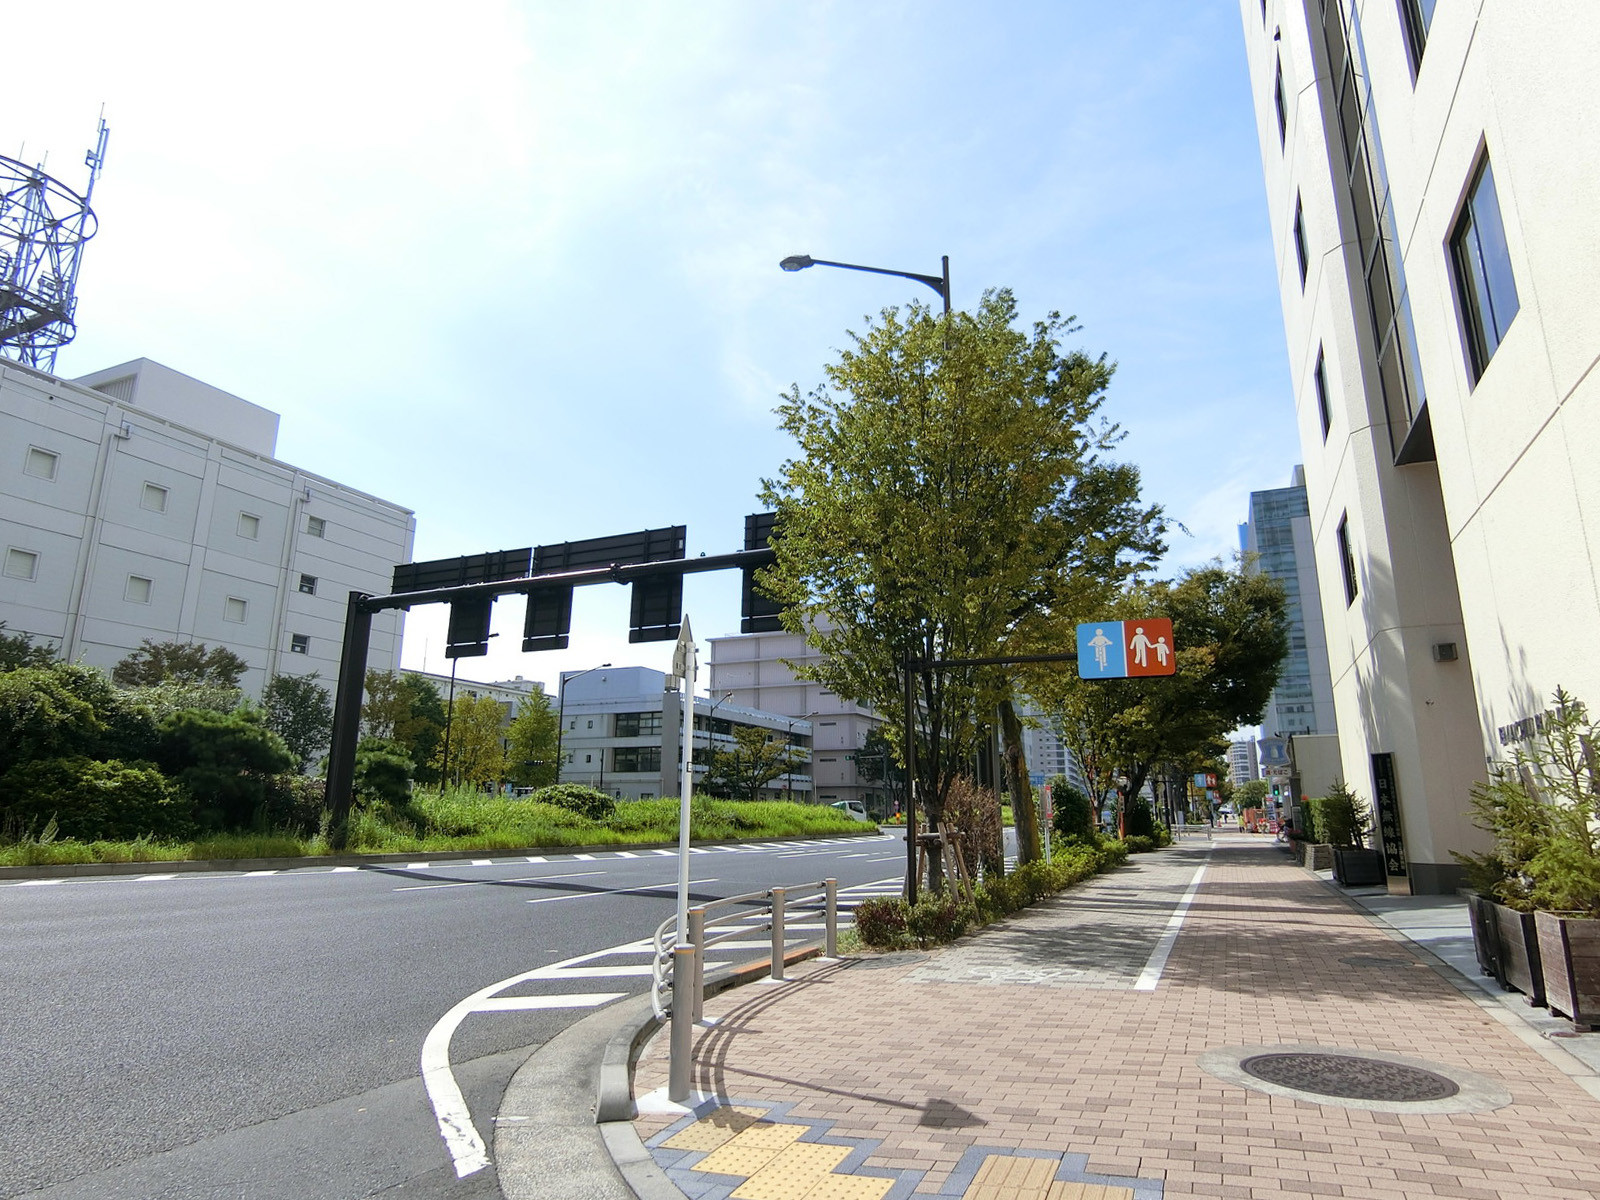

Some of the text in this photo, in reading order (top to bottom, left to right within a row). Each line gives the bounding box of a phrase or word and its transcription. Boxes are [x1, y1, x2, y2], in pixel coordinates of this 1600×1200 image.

[1378, 779, 1399, 871] 日本無線協会
